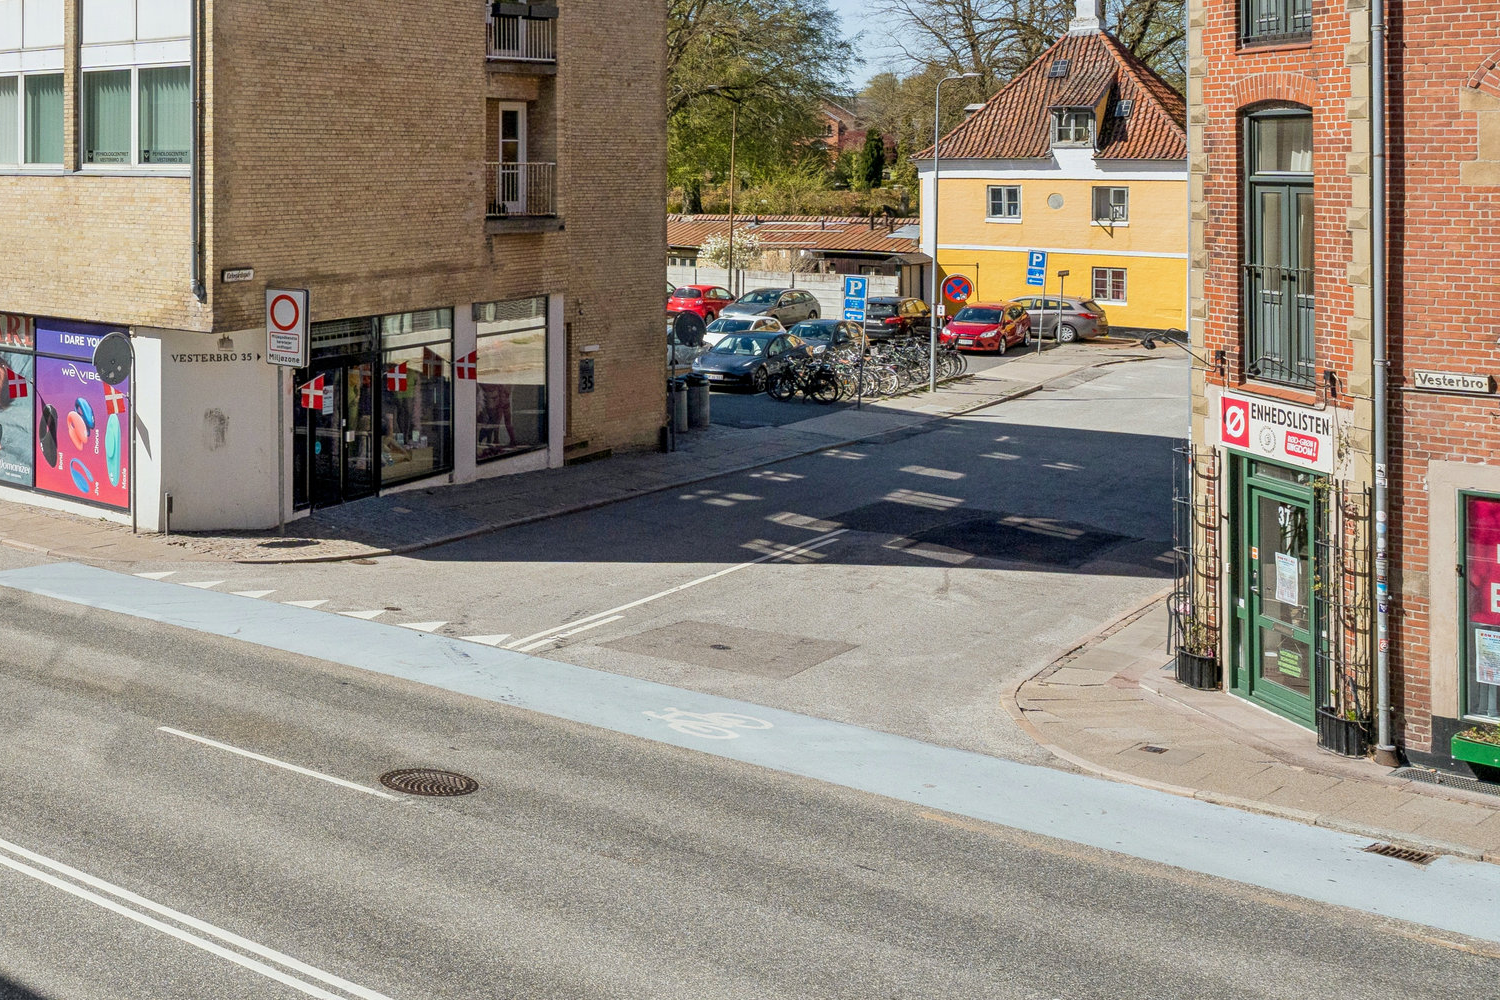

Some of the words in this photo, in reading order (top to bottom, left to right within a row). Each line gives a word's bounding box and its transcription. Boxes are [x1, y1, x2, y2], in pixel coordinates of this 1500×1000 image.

[1032, 253, 1043, 266] P
[848, 280, 863, 296] P
[64, 334, 85, 347] DARE
[171, 353, 238, 363] VESTERBRO
[241, 353, 252, 361] 35
[268, 353, 300, 364] Miljøzone
[581, 375, 593, 391] 35
[1418, 373, 1484, 389] Vesterbro
[1251, 402, 1330, 436] ENHEDSLISTEN
[1278, 506, 1291, 527] 37
